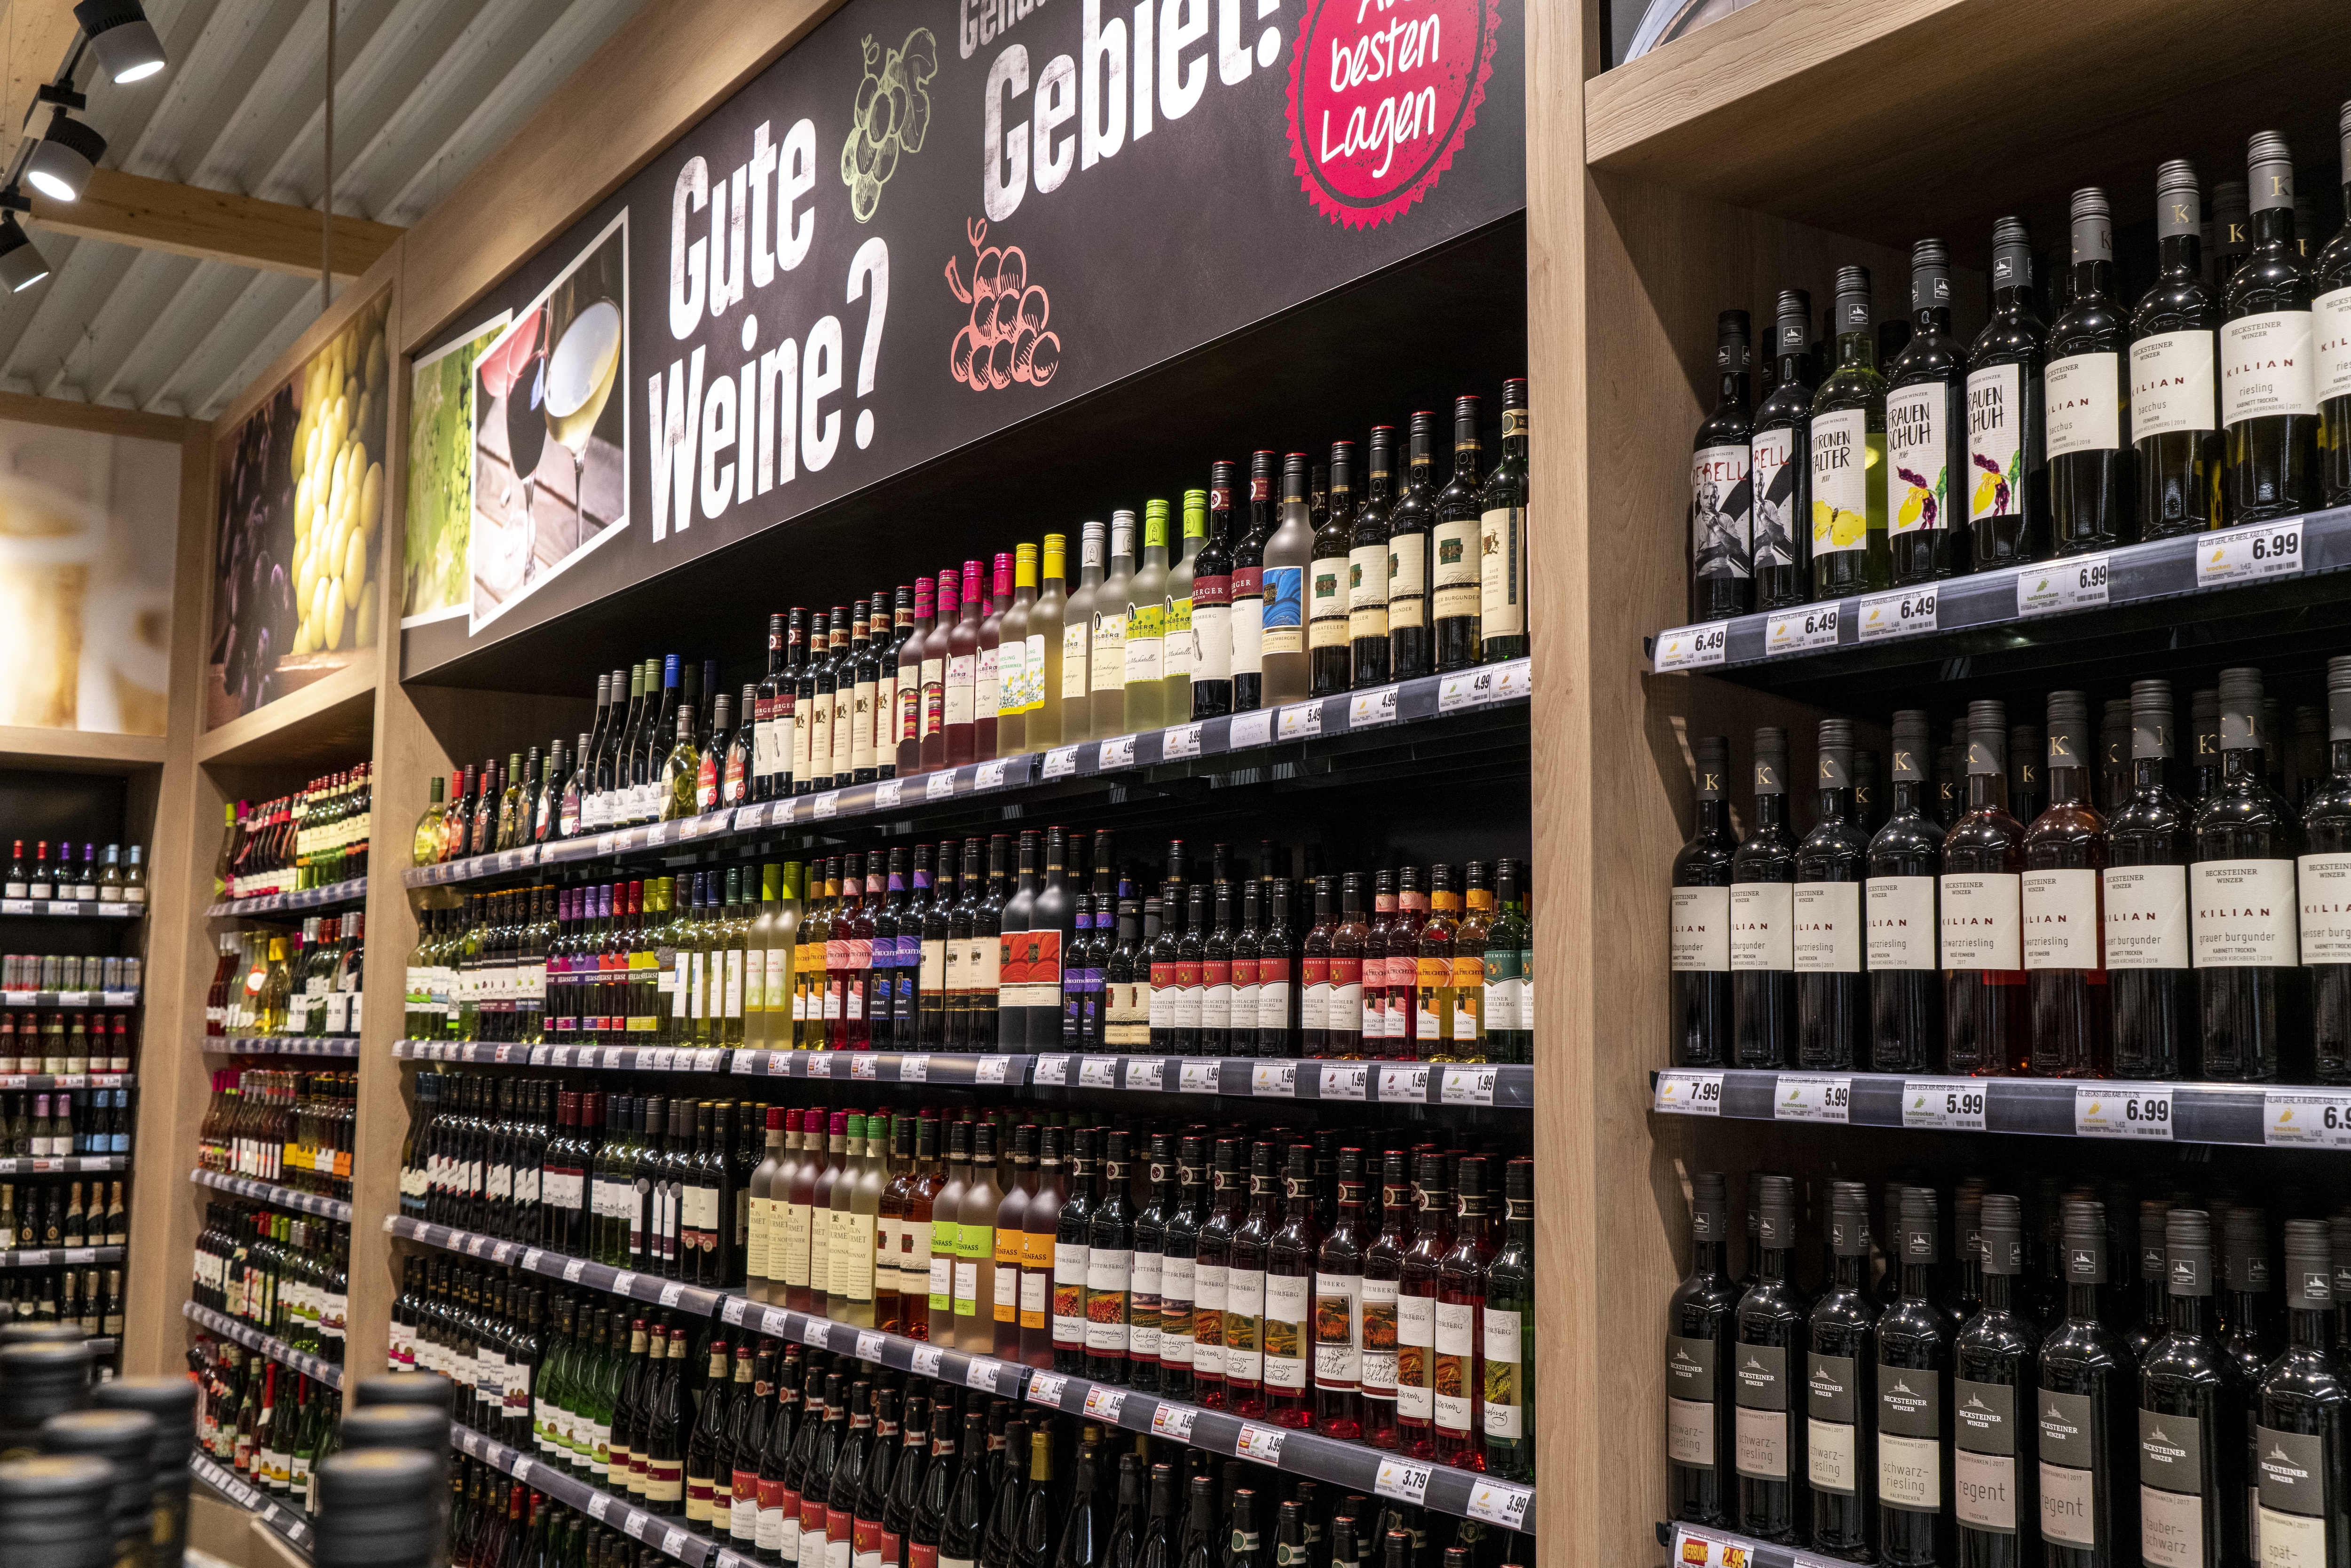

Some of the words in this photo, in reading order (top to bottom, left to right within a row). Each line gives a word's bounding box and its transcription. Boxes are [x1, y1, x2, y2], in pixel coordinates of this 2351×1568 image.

[1330, 14, 1440, 92] besten
[1321, 86, 1436, 178] Lagen
[670, 118, 816, 340] Gute
[2231, 321, 2281, 337] BECKSTEINER
[2241, 331, 2267, 340] WINZER
[2133, 341, 2173, 358] BECKSTEINER
[2139, 351, 2161, 361] WINZER
[2227, 359, 2293, 378] KILIAN
[1982, 374, 2001, 383] WINZER
[2050, 374, 2067, 383] WINZER
[648, 236, 889, 544] Weine?
[2132, 376, 2185, 398] KILIAN
[2240, 384, 2273, 397] riesling
[2138, 401, 2167, 416] bacchus
[2236, 400, 2256, 409] KABINETT
[2253, 404, 2285, 413] HERRENBERG
[1888, 402, 1930, 430] FRAUEN
[2143, 415, 2160, 424] FEINHERB
[2049, 421, 2073, 436] bacchus
[2143, 420, 2170, 432] HEILIGENBERG
[1812, 429, 1850, 454] ZITRONEN
[1888, 422, 1931, 452] SCHUH
[1813, 447, 1850, 475] FALTER
[1692, 461, 1747, 486] REBELL
[2252, 533, 2298, 559] 6.99
[2206, 563, 2231, 572] trocken
[2080, 565, 2107, 588] 6.99
[1192, 587, 1223, 598] BERGER
[2027, 591, 2059, 602] halbtrocken
[1901, 596, 1935, 619] 6.49
[1805, 612, 1837, 634] 6.49
[1695, 631, 1724, 651] 6.49
[1129, 654, 1156, 664] Muskateller
[1474, 674, 1491, 691] 4.99
[1381, 692, 1396, 708] 4.99
[1307, 706, 1321, 723] 5.49
[1189, 729, 1201, 743] 3.99
[1123, 741, 1135, 755] 4.99
[1066, 750, 1077, 763] 4.99
[2106, 874, 2144, 883] BECKSTEINER
[2206, 868, 2257, 877] BECKSTEINER
[2201, 908, 2270, 918] KILIAN
[1942, 917, 1993, 926] KILIAN
[2118, 935, 2162, 947] burgunder
[2200, 933, 2223, 946] grauer
[2225, 931, 2276, 944] burgunder
[2302, 929, 2326, 939] weisser
[1942, 938, 1994, 949] schwarzriesling
[918, 1060, 927, 1072] 5.99
[996, 1062, 1006, 1074] 4.79
[1056, 1061, 1067, 1073] 1.99
[1104, 1064, 1115, 1077] 1.99
[1151, 1065, 1162, 1078] 1.99
[1206, 1067, 1218, 1081] 1.99
[1281, 1069, 1294, 1083] 1.99
[1352, 1072, 1365, 1087] 1.99
[1412, 1072, 1427, 1087] 1.99
[1478, 1074, 1494, 1091] 1.99
[1691, 1082, 1720, 1101] 7.99
[1825, 1087, 1848, 1107] 5.99
[1946, 1094, 1983, 1114] 5.99
[2126, 1099, 2169, 1121] 6.99
[1086, 1326, 1123, 1341] Schwarzriesling
[1670, 1362, 1703, 1373] BECKSTEINER
[987, 1369, 998, 1382] 4.99
[1739, 1371, 1775, 1382] BECKSTEINER
[1052, 1381, 1065, 1394] 3.99
[1810, 1380, 1843, 1392] BECKSTEINER
[1815, 1389, 1832, 1398] WINZER
[1089, 1391, 1100, 1400] UNSER
[1884, 1395, 1927, 1406] BECKSTEINER
[1110, 1396, 1122, 1411] 3.99
[1892, 1404, 1915, 1412] WINZER
[1156, 1408, 1168, 1417] UNSER
[1959, 1410, 2002, 1423] BECKSTEINER
[1180, 1414, 1194, 1430] 3.99
[1967, 1419, 1989, 1428] WINZER
[2040, 1420, 2078, 1434] BECKSTEINER
[1242, 1429, 1253, 1439] UNSER
[1739, 1433, 1777, 1448] schwarz-
[2046, 1430, 2066, 1440] WINZER
[1267, 1436, 1282, 1452] 3.99
[2143, 1442, 2186, 1458] BECKSTEINER
[1741, 1447, 1773, 1465] riesling
[1810, 1445, 1844, 1461] schwarz-
[2150, 1452, 2173, 1463] WINZER
[1811, 1458, 1840, 1477] riesling
[1884, 1461, 1929, 1477] schwarz-
[2261, 1461, 2308, 1479] BECKSTEINER
[1402, 1470, 1427, 1489] 3.79
[1886, 1477, 1925, 1495] riesling
[2269, 1473, 2295, 1484] WINZER
[1890, 1491, 1920, 1502] HALBTROCKEN
[1959, 1480, 2005, 1503] regent
[1507, 1494, 1527, 1513] 3.99
[2041, 1494, 2083, 1518] regent
[1969, 1512, 1988, 1521] TROCKEN
[2146, 1517, 2184, 1536] tauber-
[2145, 1534, 2186, 1554] schwarz
[1682, 1543, 1708, 1562] WERBUNG
[1722, 1546, 1745, 1568] 2.99
[2269, 1544, 2298, 1562] spät-
